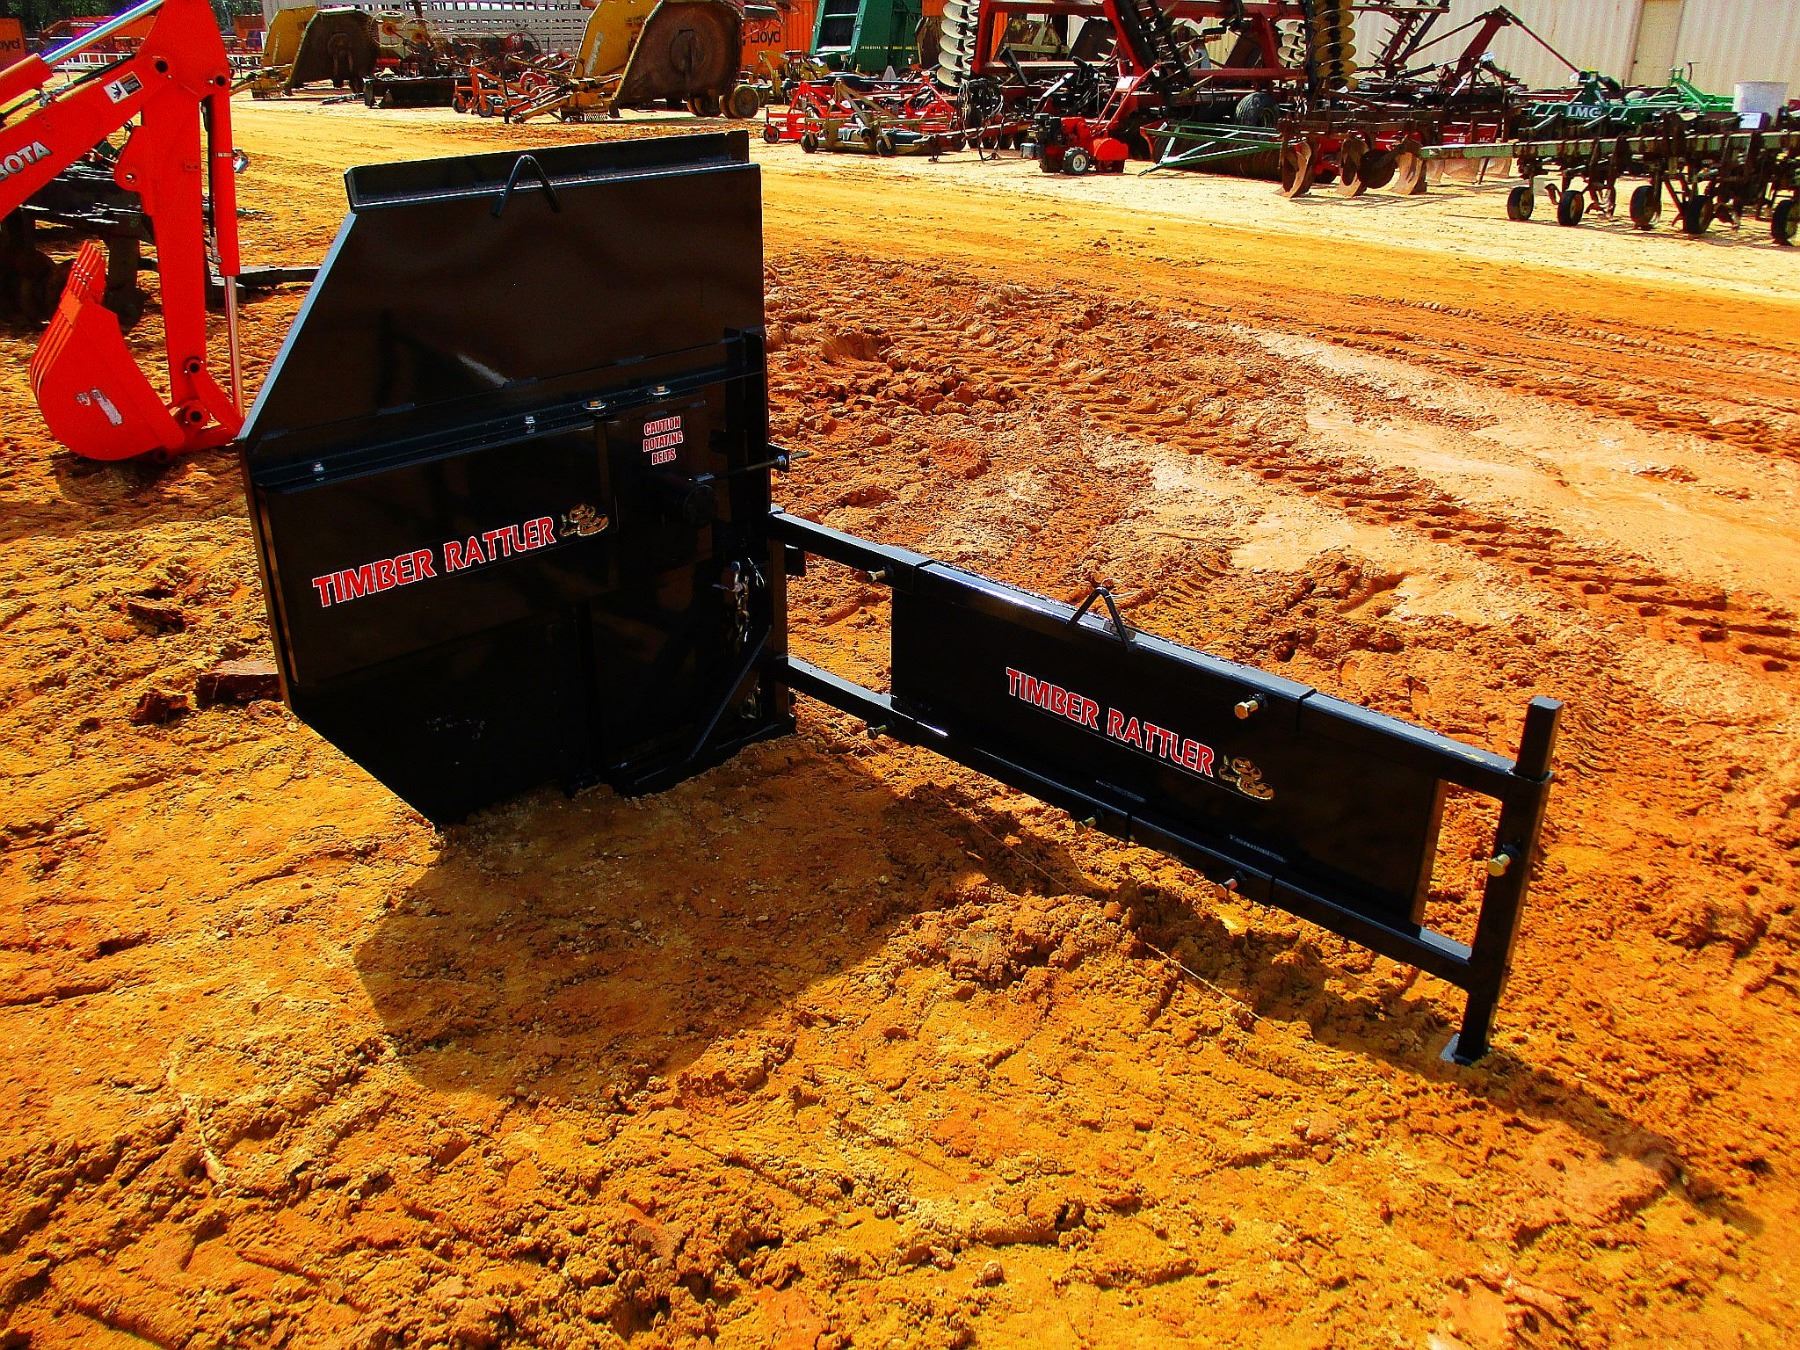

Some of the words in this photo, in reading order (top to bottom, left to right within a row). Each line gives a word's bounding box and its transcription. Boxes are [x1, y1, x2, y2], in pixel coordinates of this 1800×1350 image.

[644, 416, 681, 436] CAUTION
[643, 431, 684, 452] ROTATING
[652, 448, 677, 465] BELTS
[312, 549, 437, 607] TIMBER
[443, 517, 557, 573] RATTLER
[1006, 667, 1100, 730] TIMBER
[1107, 707, 1215, 777] RATTLER
